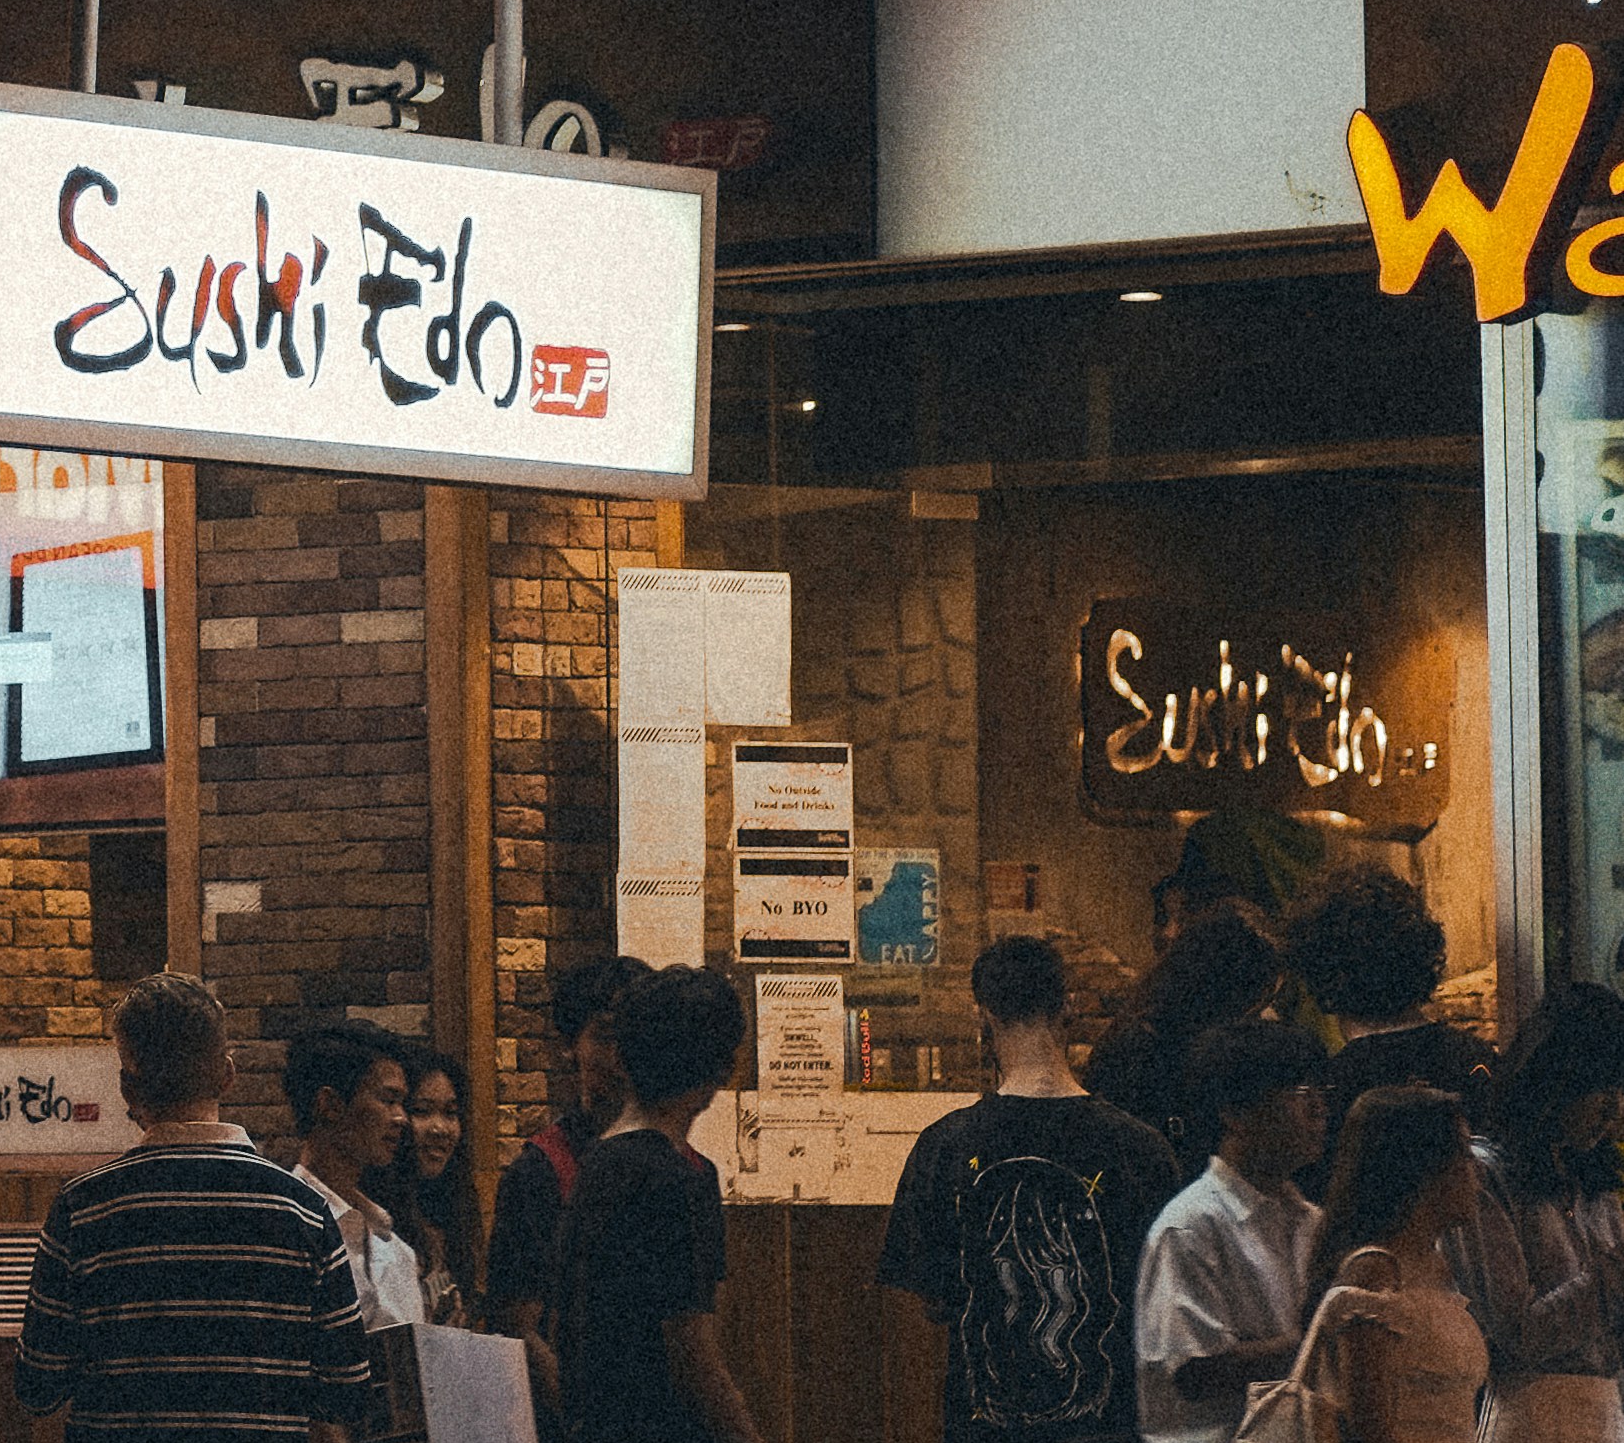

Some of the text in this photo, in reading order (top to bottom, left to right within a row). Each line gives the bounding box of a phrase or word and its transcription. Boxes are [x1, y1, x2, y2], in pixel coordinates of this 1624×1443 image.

[53, 165, 329, 395] Sushi
[358, 200, 524, 410] Edo
[1105, 627, 1390, 788] Sushi Edo
[768, 784, 822, 796] No Outside
[754, 800, 836, 811] Food and Drinks
[760, 900, 829, 916] No BYO
[768, 1060, 781, 1072] DO
[782, 1060, 801, 1071] NOT
[17, 1075, 73, 1124] Edo
